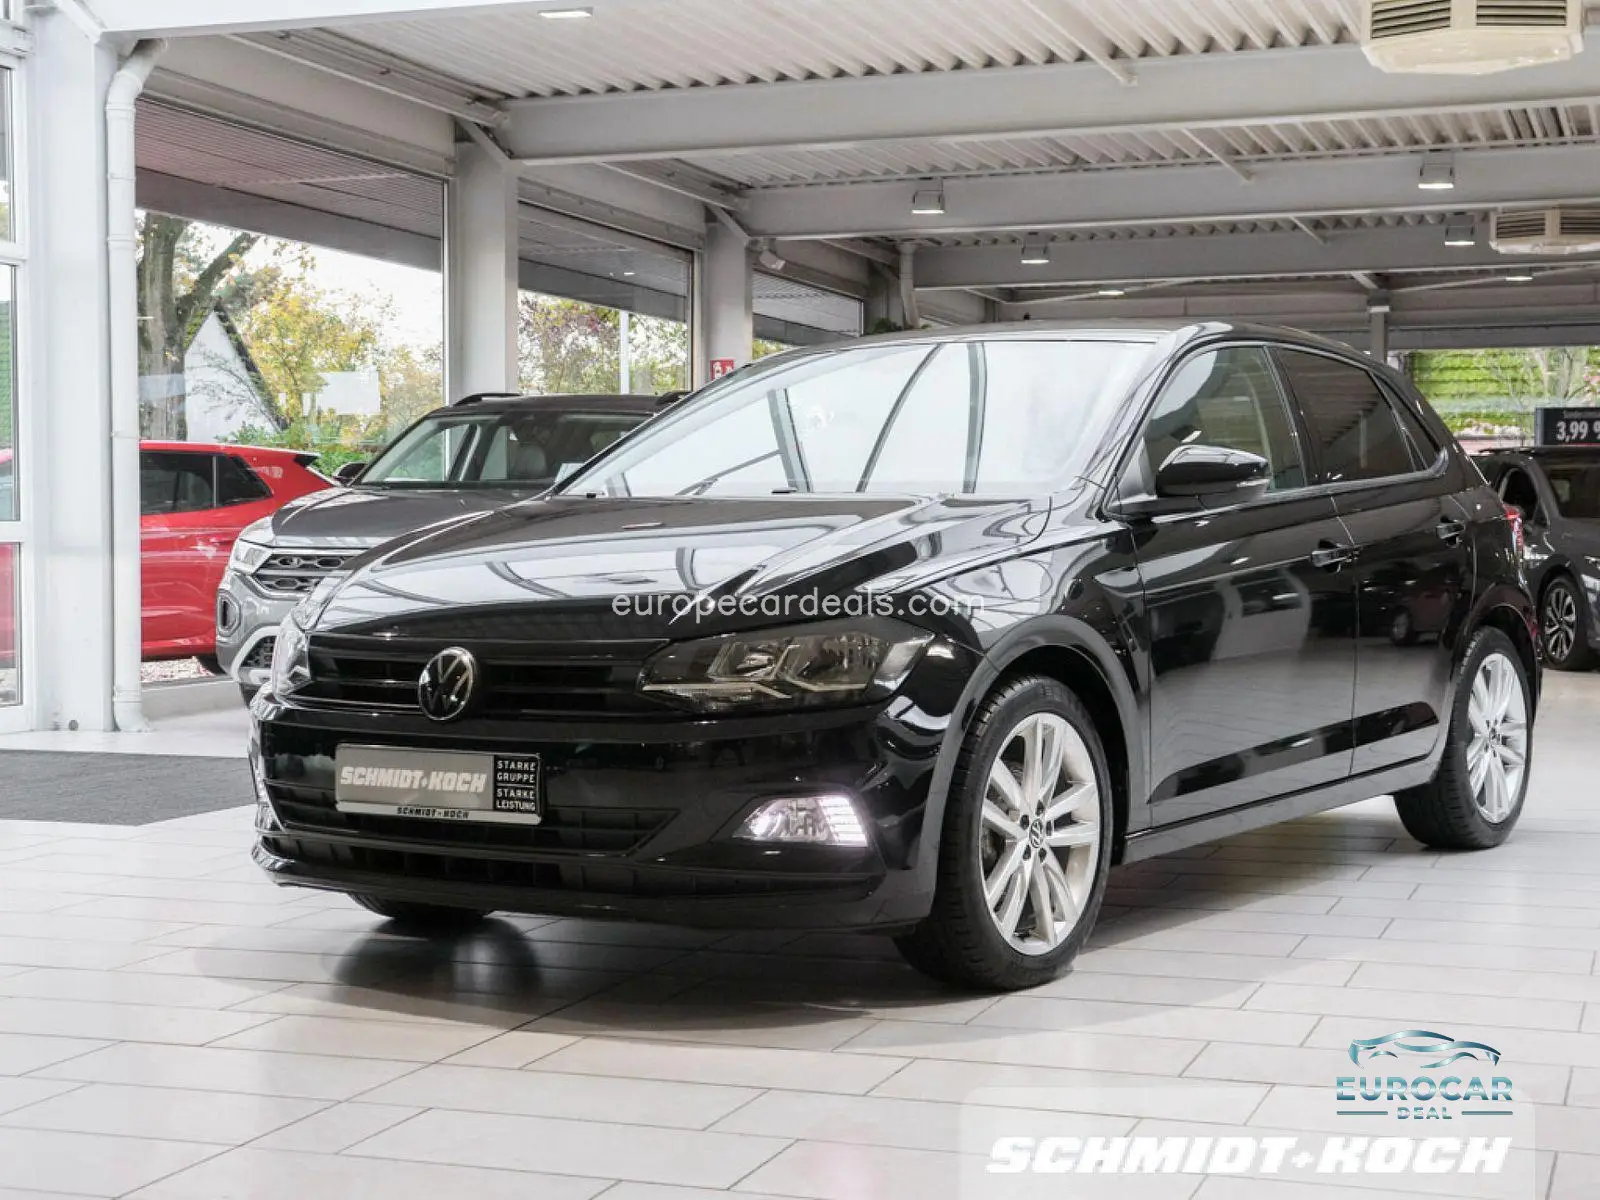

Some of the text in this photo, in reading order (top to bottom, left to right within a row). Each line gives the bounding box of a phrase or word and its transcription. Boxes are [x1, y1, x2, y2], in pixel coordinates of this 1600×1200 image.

[1556, 420, 1589, 443] 3,99
[496, 760, 536, 771] STARKE
[496, 772, 536, 783] GRUPPE
[496, 788, 535, 799] STARKE
[496, 799, 536, 811] LEISTUNG
